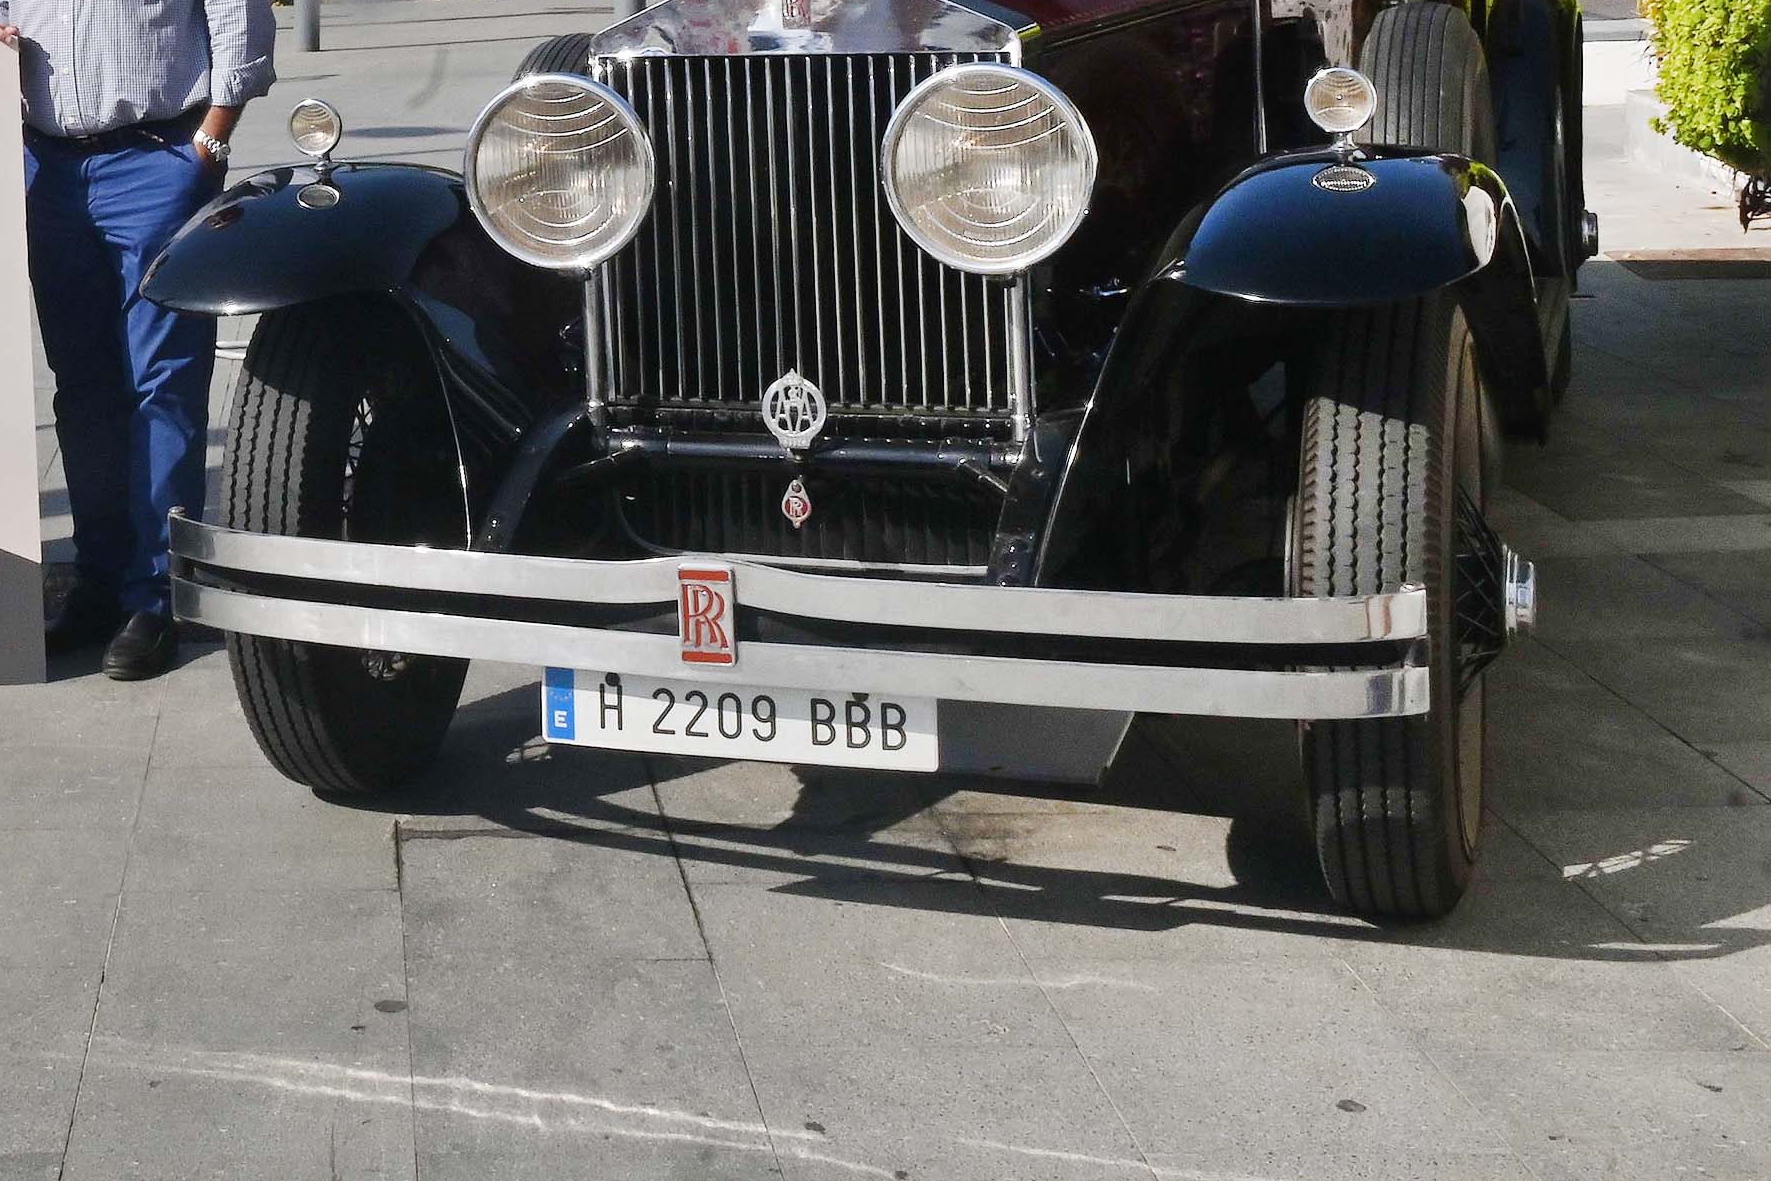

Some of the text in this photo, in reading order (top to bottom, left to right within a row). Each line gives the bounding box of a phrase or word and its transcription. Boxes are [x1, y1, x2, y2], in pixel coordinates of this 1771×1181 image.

[681, 583, 729, 649] RR
[554, 683, 907, 751] E H 2209 BBB
